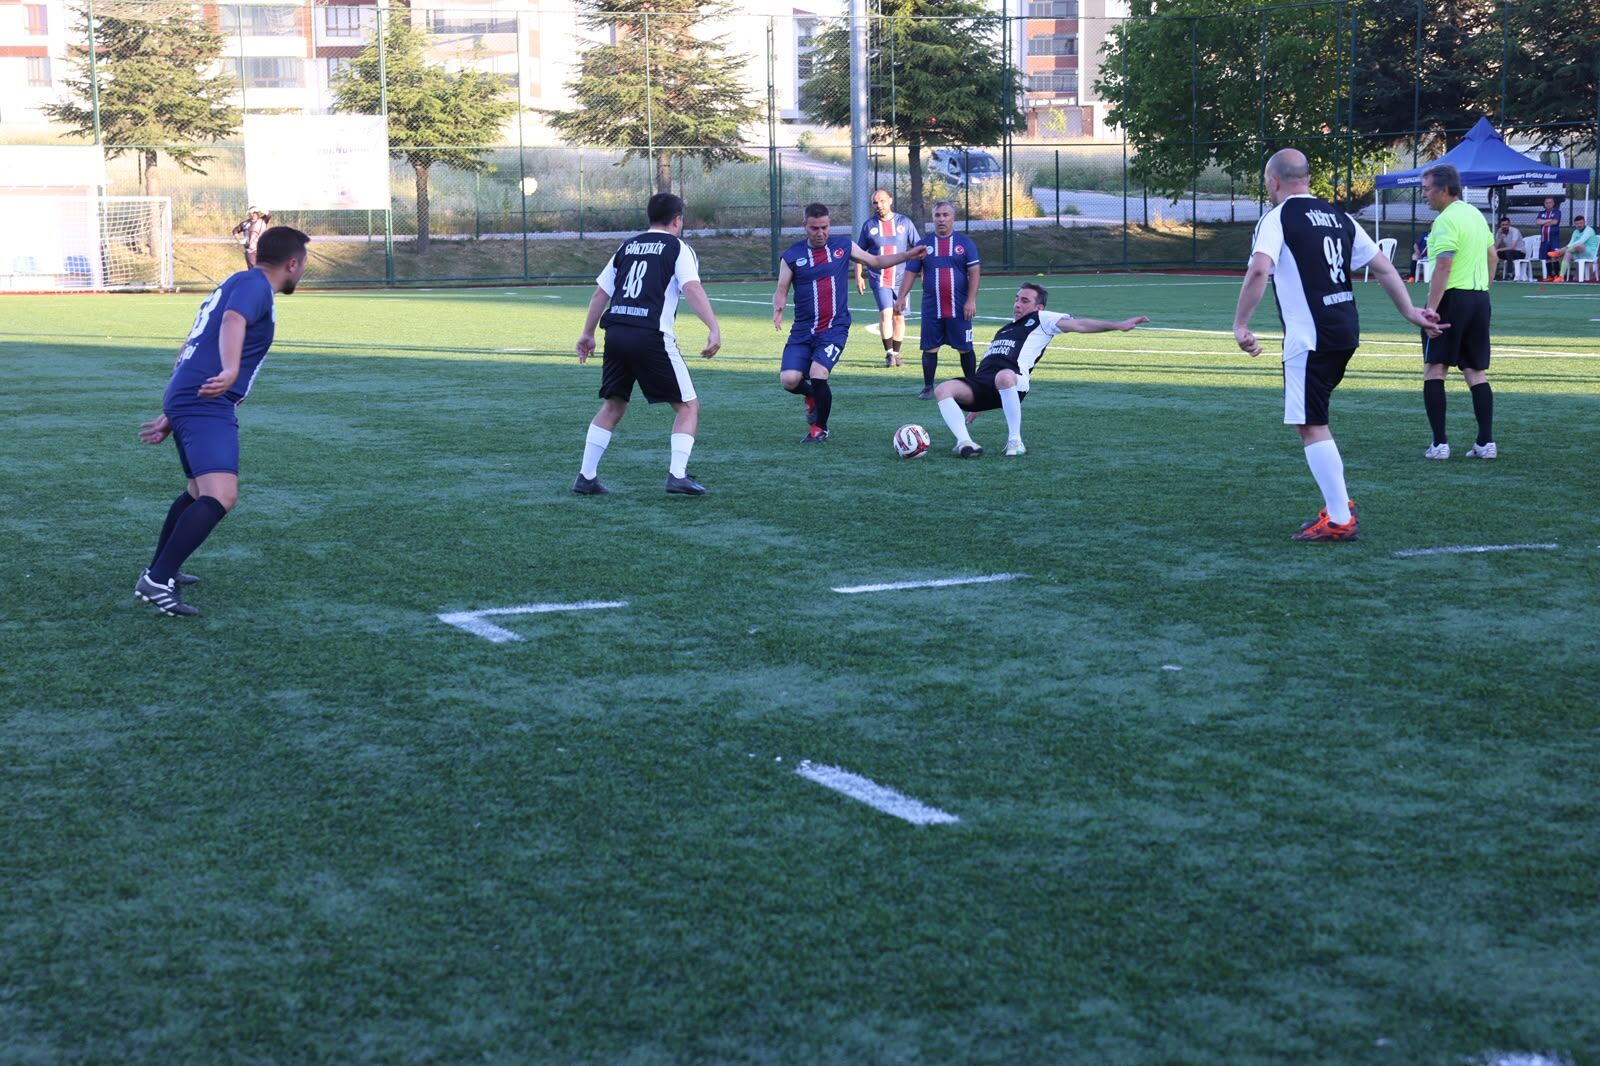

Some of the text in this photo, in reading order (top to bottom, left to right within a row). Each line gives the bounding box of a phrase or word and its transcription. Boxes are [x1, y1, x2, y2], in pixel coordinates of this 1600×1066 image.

[1323, 235, 1346, 284] 94
[622, 260, 648, 299] 48
[824, 343, 841, 362] 47
